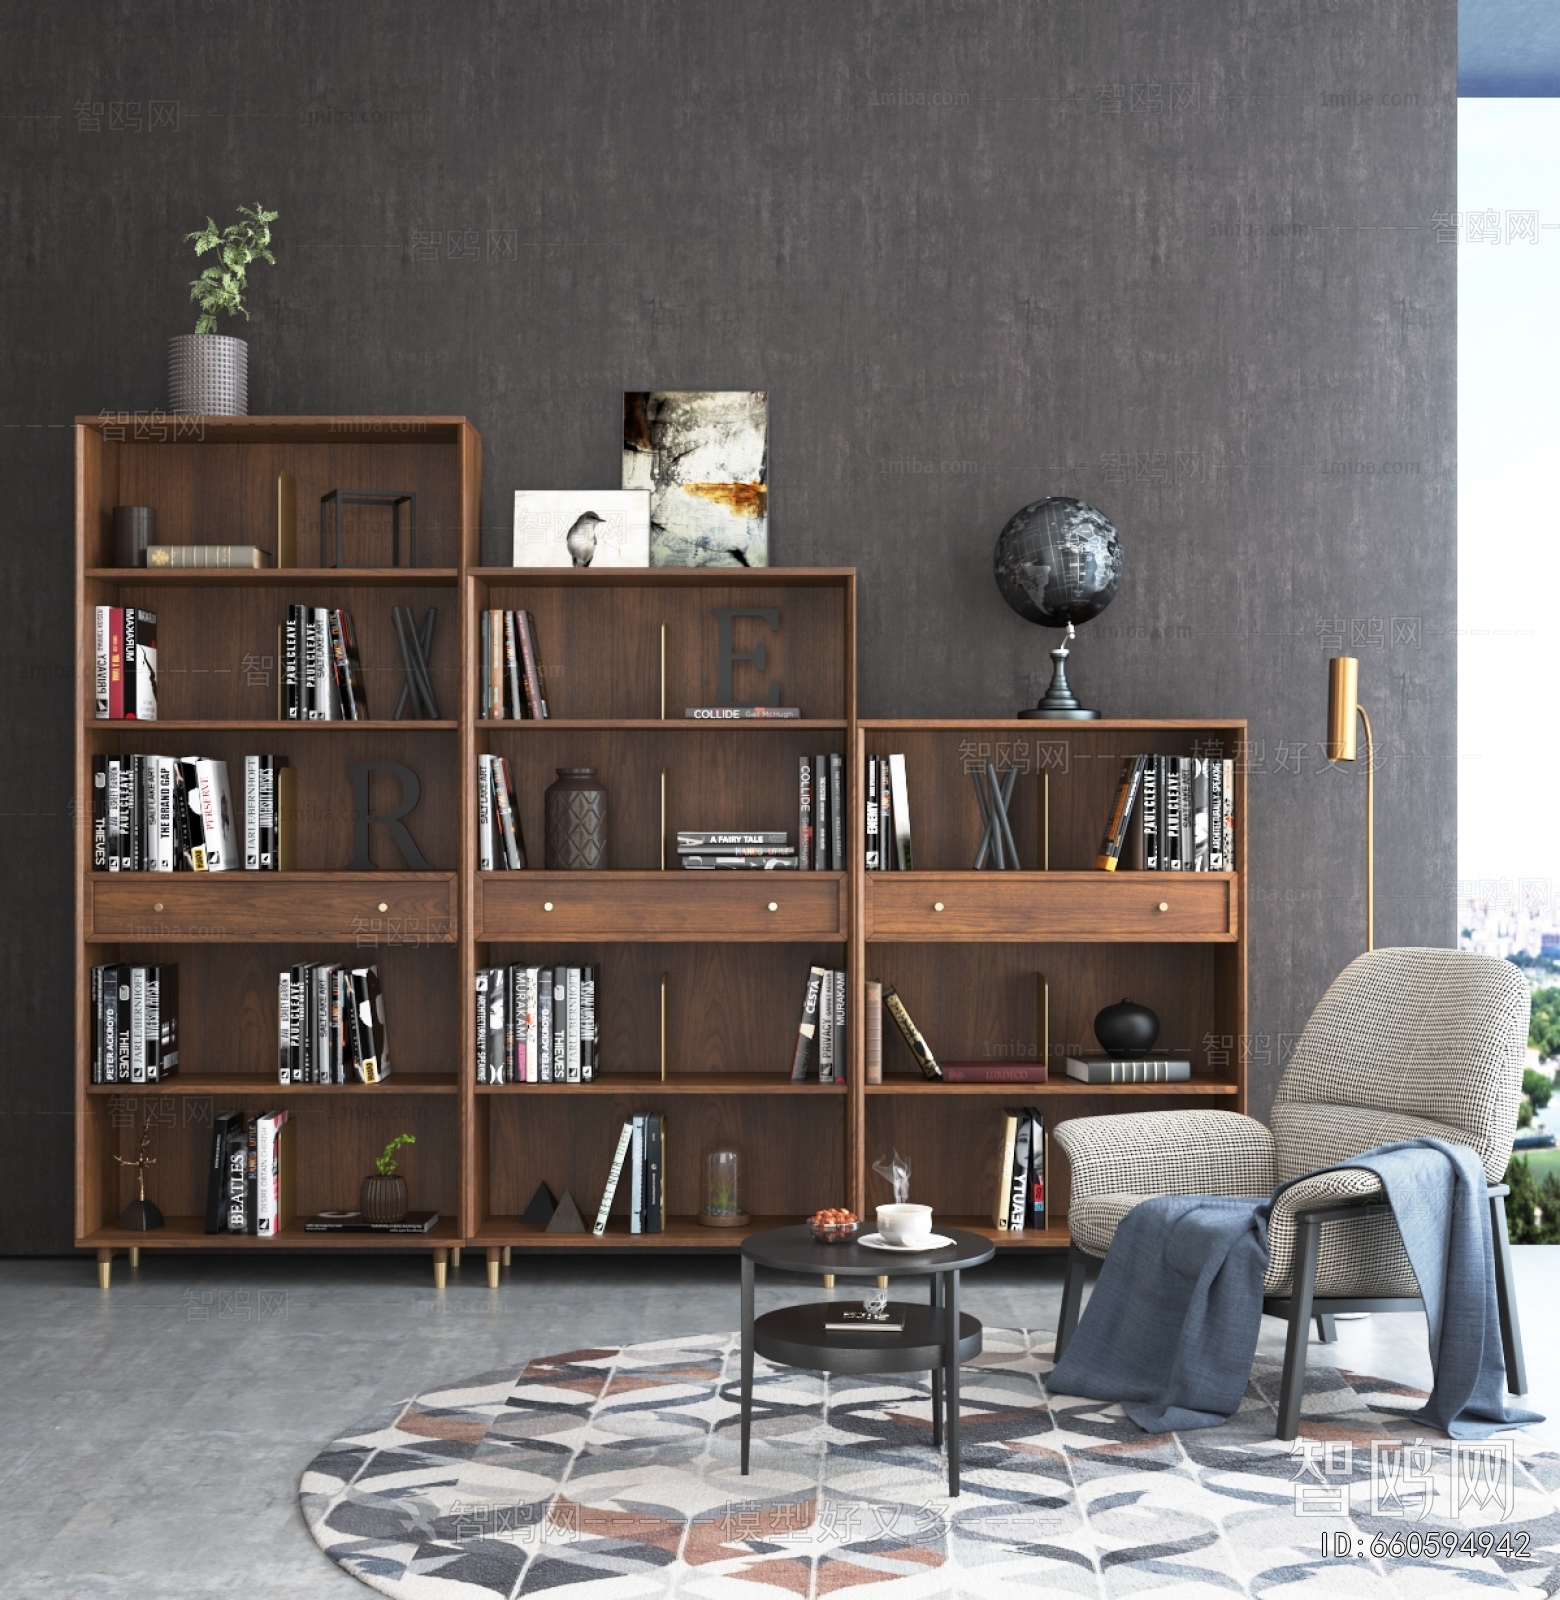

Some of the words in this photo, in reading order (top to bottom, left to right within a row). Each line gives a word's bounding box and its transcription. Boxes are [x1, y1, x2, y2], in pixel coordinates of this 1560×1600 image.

[286, 620, 296, 657] CLEAVE
[306, 622, 316, 660] CLEAVE
[286, 658, 296, 685] PAUL
[306, 662, 316, 688] PAUL
[693, 709, 740, 719] COLLIDE
[160, 767, 170, 787] GAP
[479, 765, 488, 782] ART
[800, 765, 811, 812] COLLIDE
[1143, 769, 1156, 807] CLEAVE
[160, 788, 170, 820] BRAND
[200, 775, 215, 831] PERSERVE
[480, 783, 489, 804] LAKE
[1168, 772, 1179, 810] CLEAVE
[160, 821, 170, 839] THE
[480, 806, 489, 824] SALT
[866, 801, 879, 835] ENEMY
[1143, 808, 1156, 835] PAUL
[1168, 811, 1179, 837] PAUL
[95, 818, 106, 866] THIEVES
[710, 836, 718, 844] A
[718, 836, 742, 844] FAIRY
[743, 836, 764, 844] TALE
[515, 972, 526, 1040] MURAKAMI
[805, 981, 820, 1014] CESTA
[836, 972, 846, 1026] MURAKAMI
[105, 1008, 114, 1052] ACKROYD
[290, 1021, 300, 1047] PAUL
[541, 1008, 550, 1052] ACKROYD
[822, 1018, 832, 1059] PRIVACY
[105, 1053, 114, 1081] PETER
[119, 1030, 130, 1079] THIEVES
[541, 1053, 550, 1081] PETER
[554, 1029, 565, 1078] THIEVES
[986, 1070, 1028, 1080] LUXDECO
[260, 1127, 269, 1159] CHERISH
[230, 1153, 245, 1225] BEATLES
[260, 1159, 269, 1188] OBTAIN
[260, 1188, 269, 1213] DESIRE
